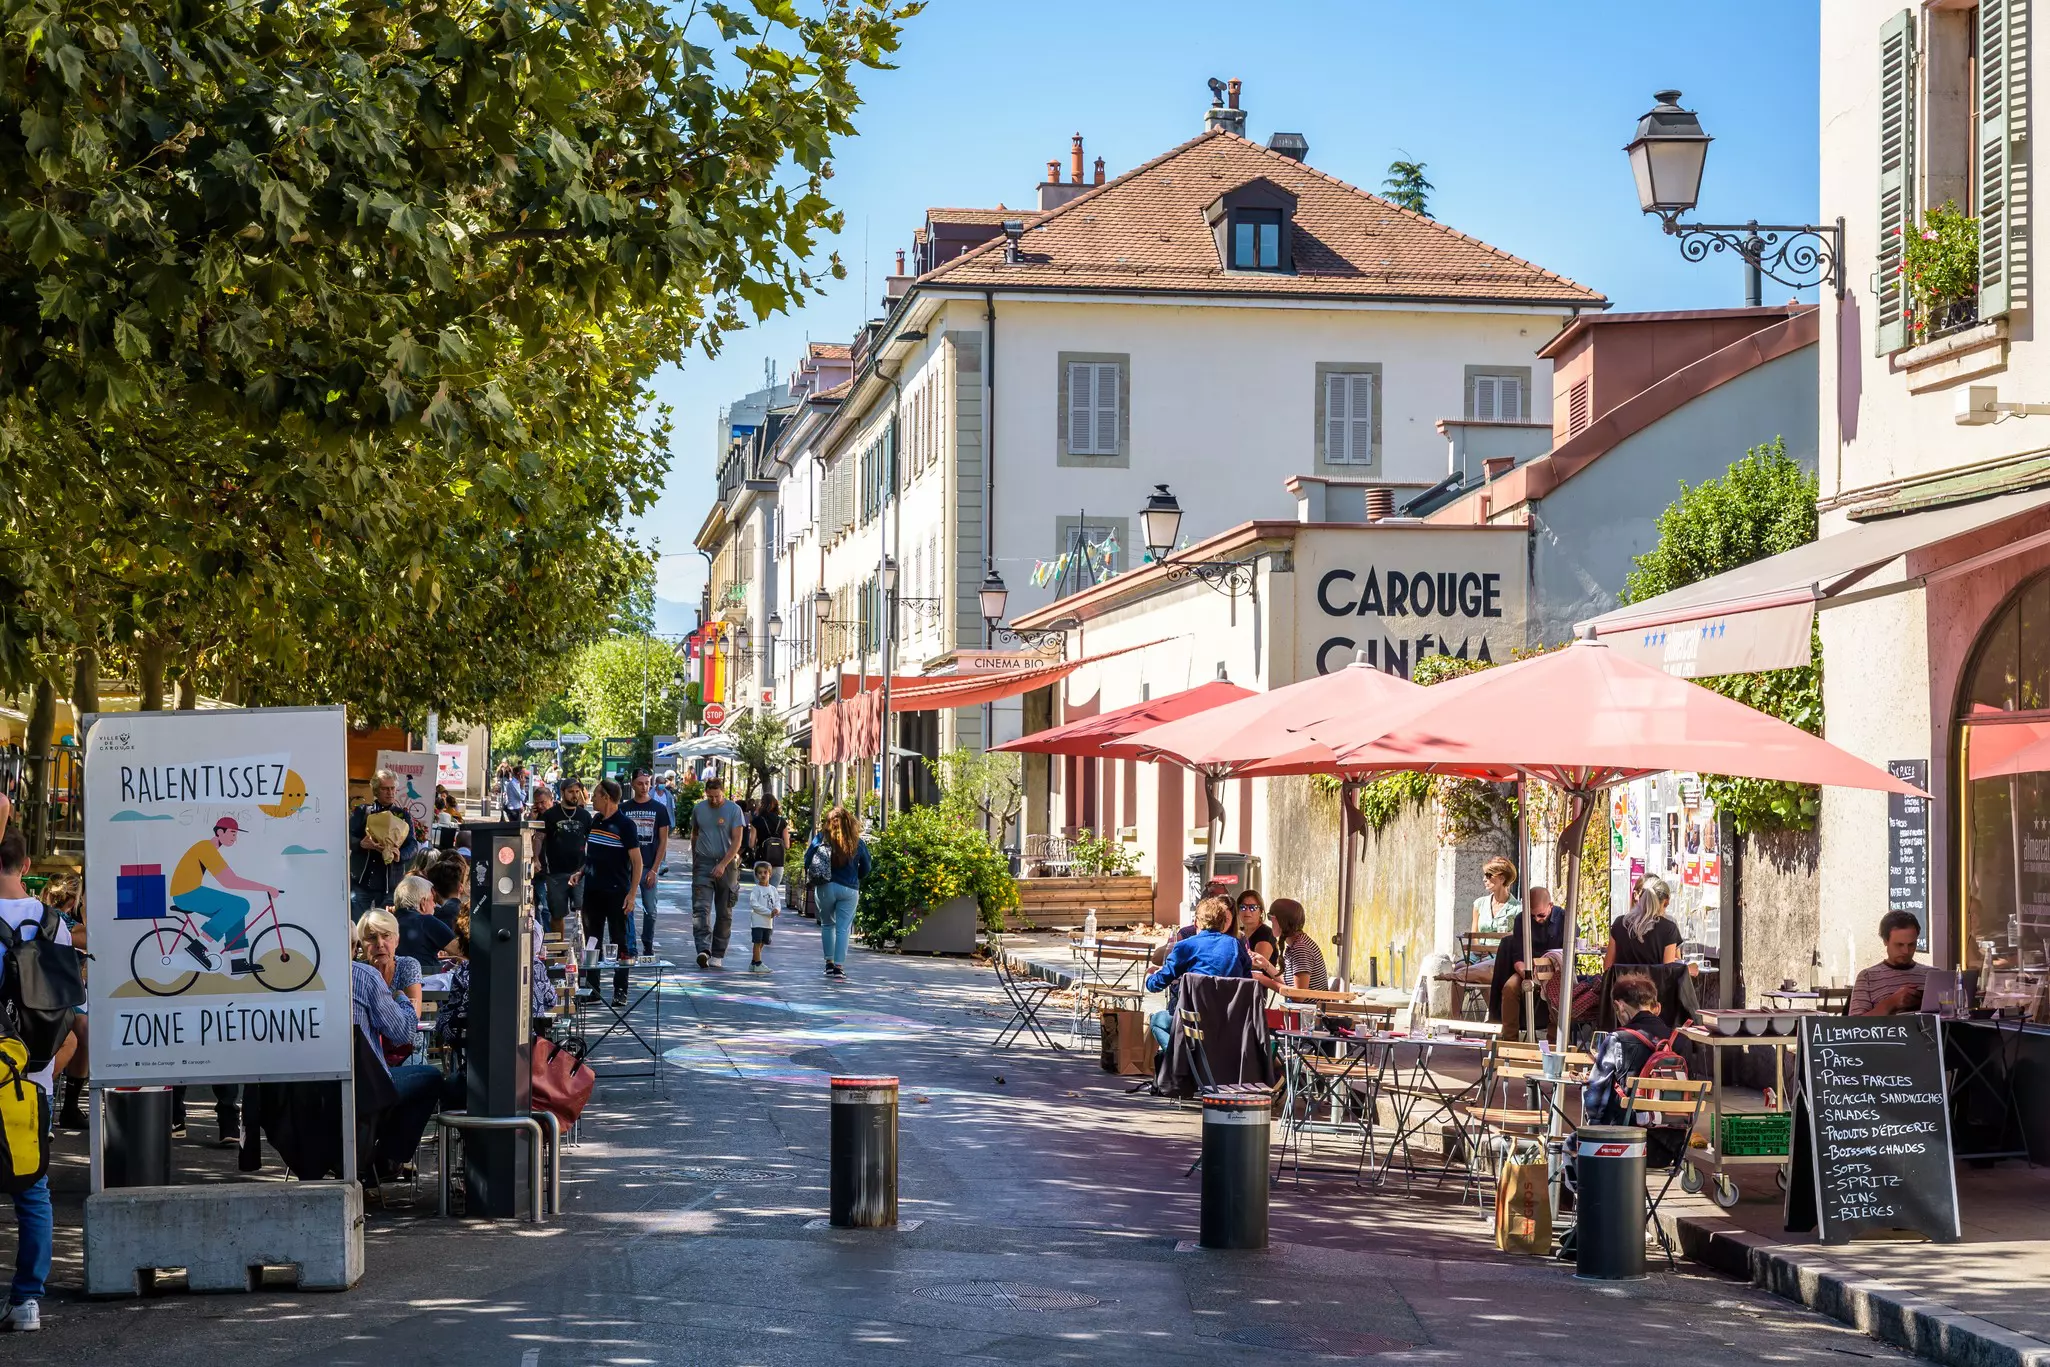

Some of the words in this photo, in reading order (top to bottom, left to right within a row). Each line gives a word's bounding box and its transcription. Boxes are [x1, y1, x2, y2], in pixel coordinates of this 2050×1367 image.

[1317, 564, 1502, 618] CAROUGE
[974, 658, 1020, 669] CINEMA
[1024, 658, 1044, 669] BIO
[706, 710, 723, 719] STOP
[120, 1012, 184, 1048] ZONE
[200, 1002, 320, 1047] PIÉTONNE
[1826, 1026, 1908, 1042] L'EMPORTER
[1861, 1074, 1913, 1087] FARCIES
[1880, 1092, 1944, 1105] SANDWICHES
[1871, 1122, 1938, 1138] D'ÉPICERIE
[1879, 1143, 1926, 1155] CHAUDES
